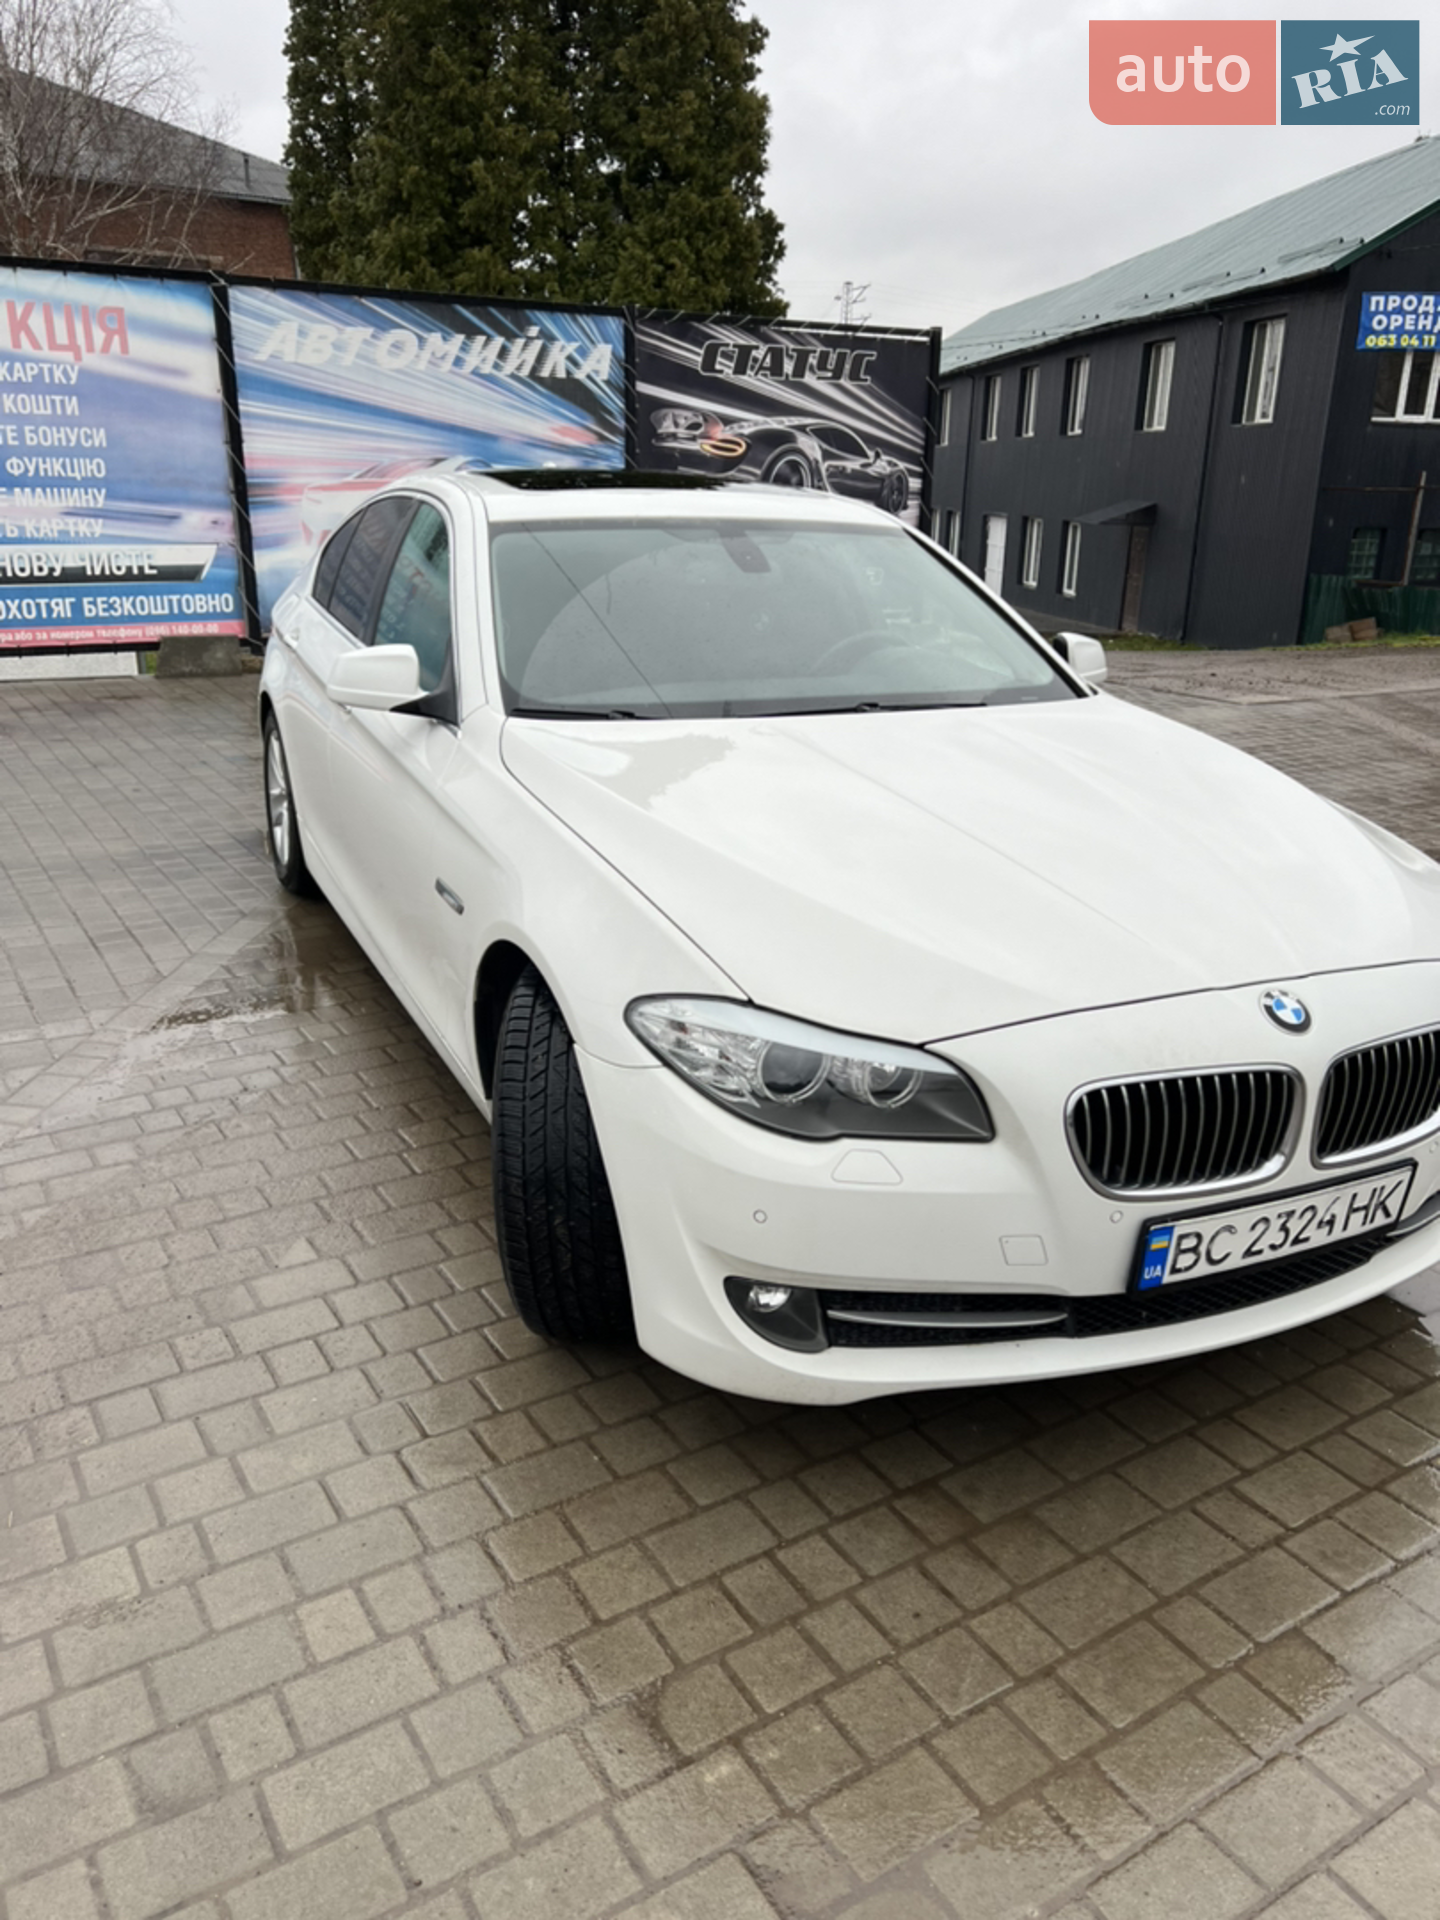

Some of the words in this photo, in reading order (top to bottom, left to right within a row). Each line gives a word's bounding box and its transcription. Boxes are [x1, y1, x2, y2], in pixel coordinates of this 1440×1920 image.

[1369, 294, 1440, 314] ПРОД
[6, 300, 130, 363] КЦІЯ
[1365, 334, 1397, 348] 063
[1400, 334, 1419, 348] 04
[254, 321, 613, 381] АВТОМИЙКА
[699, 339, 877, 385] СТАТУС
[0, 362, 79, 384] КАРТКУ
[3, 393, 79, 416] КОШТИ
[24, 425, 107, 448] БОНУСИ
[5, 456, 107, 481] ФУНКЦІЮ
[14, 487, 106, 508] МАШИНУ
[24, 518, 103, 539] КАРТКУ
[76, 551, 158, 576] ЧИСТЕ
[83, 593, 234, 619] БЕЗКОШТОВНО
[1168, 1225, 1239, 1276] BC
[1241, 1196, 1341, 1260] 2324
[1342, 1180, 1404, 1232] HK
[1144, 1267, 1163, 1280] UA
